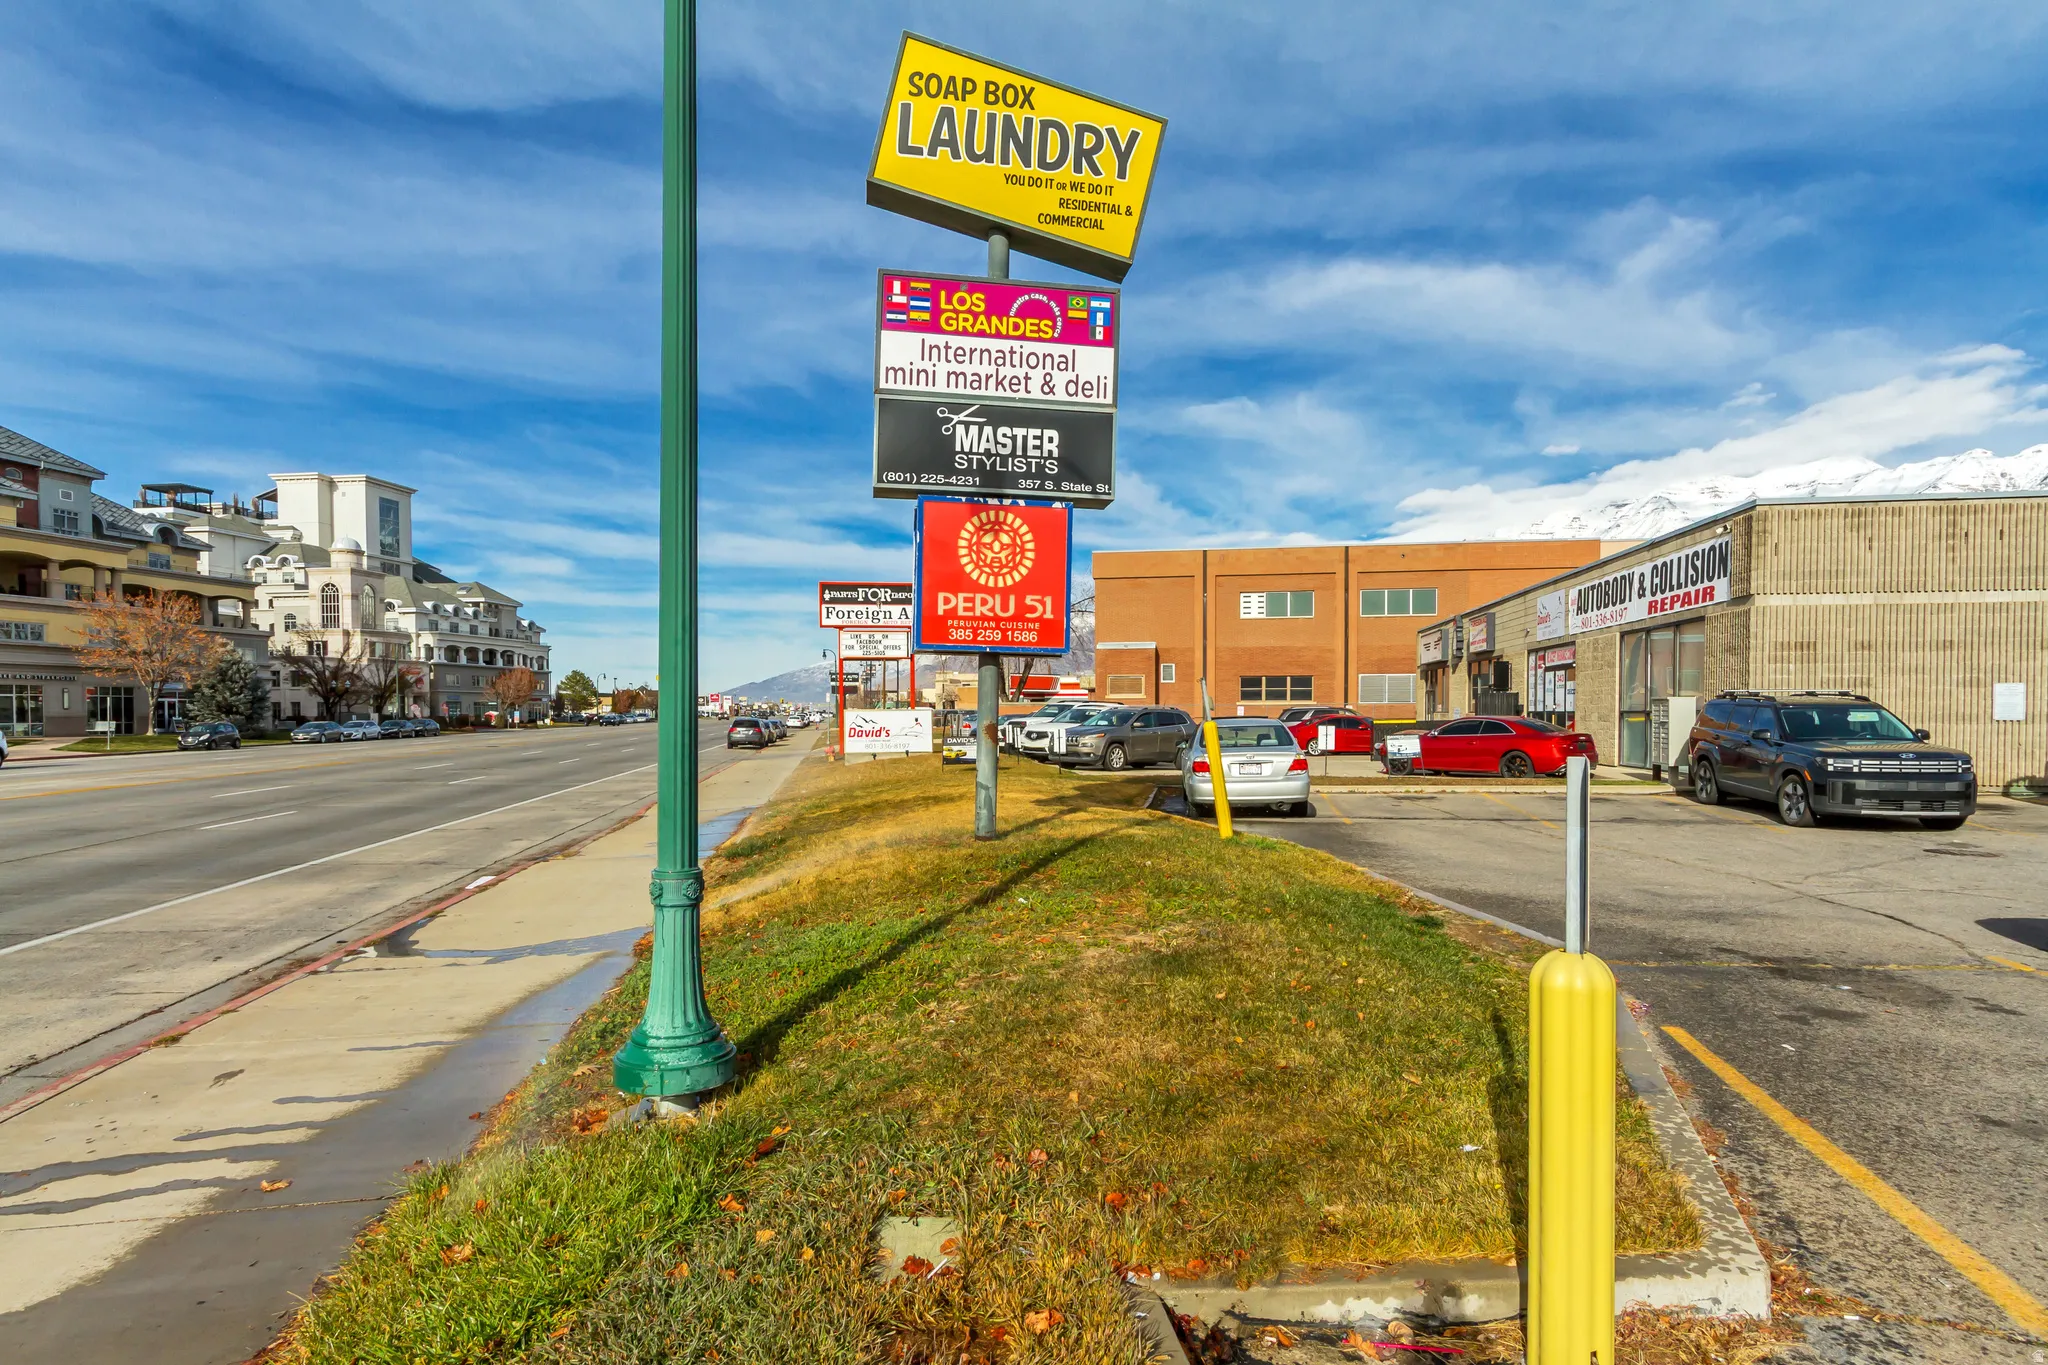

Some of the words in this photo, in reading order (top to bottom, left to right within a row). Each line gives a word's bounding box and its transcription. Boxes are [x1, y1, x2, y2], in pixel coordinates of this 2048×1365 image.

[908, 71, 977, 102] SOAP
[984, 81, 1036, 111] BOX
[896, 101, 1142, 181] LAUNDRY
[1004, 173, 1025, 186] YOU
[1027, 175, 1043, 188] DO
[1045, 178, 1055, 190] IT
[1069, 181, 1086, 193] WE
[1087, 183, 1103, 195] DO
[1104, 185, 1115, 196] IT
[1058, 197, 1123, 216] RESIDENTIAL
[1124, 205, 1133, 216] &
[1037, 212, 1105, 231] COMMERCIAL
[940, 290, 986, 312] LOS
[940, 312, 1054, 339] GRANDES
[1009, 294, 1029, 317] nuestra
[1053, 316, 1062, 338] cerca
[920, 337, 1077, 373] International
[884, 361, 937, 388] mini
[946, 367, 1032, 394] market
[1040, 371, 1056, 396] &
[1064, 374, 1108, 400] deli
[955, 423, 1060, 458] MASTER
[954, 454, 1059, 474] STYLIST'S
[882, 471, 917, 484] (801)
[920, 473, 981, 486] 225-4231
[1018, 479, 1042, 490] 357
[1044, 480, 1057, 491] S.
[1060, 481, 1093, 493] State
[1095, 483, 1113, 494] St.
[1576, 570, 1635, 617] AUTOBODY
[1637, 571, 1647, 600] &
[1650, 540, 1730, 598] COLLISION
[857, 587, 892, 602] FOR
[937, 592, 1015, 618] PERU
[1024, 595, 1054, 619] 51
[1647, 585, 1716, 616] REPAIR
[825, 606, 893, 624] Foreign
[897, 607, 912, 620] A
[947, 620, 996, 629] PERUVIAN
[1000, 621, 1041, 630] CUISINE
[1580, 607, 1628, 630] 801-336-8197
[948, 628, 973, 641] 385
[976, 629, 1002, 641] 259
[1006, 630, 1038, 643] 1586
[848, 727, 891, 738] David's
